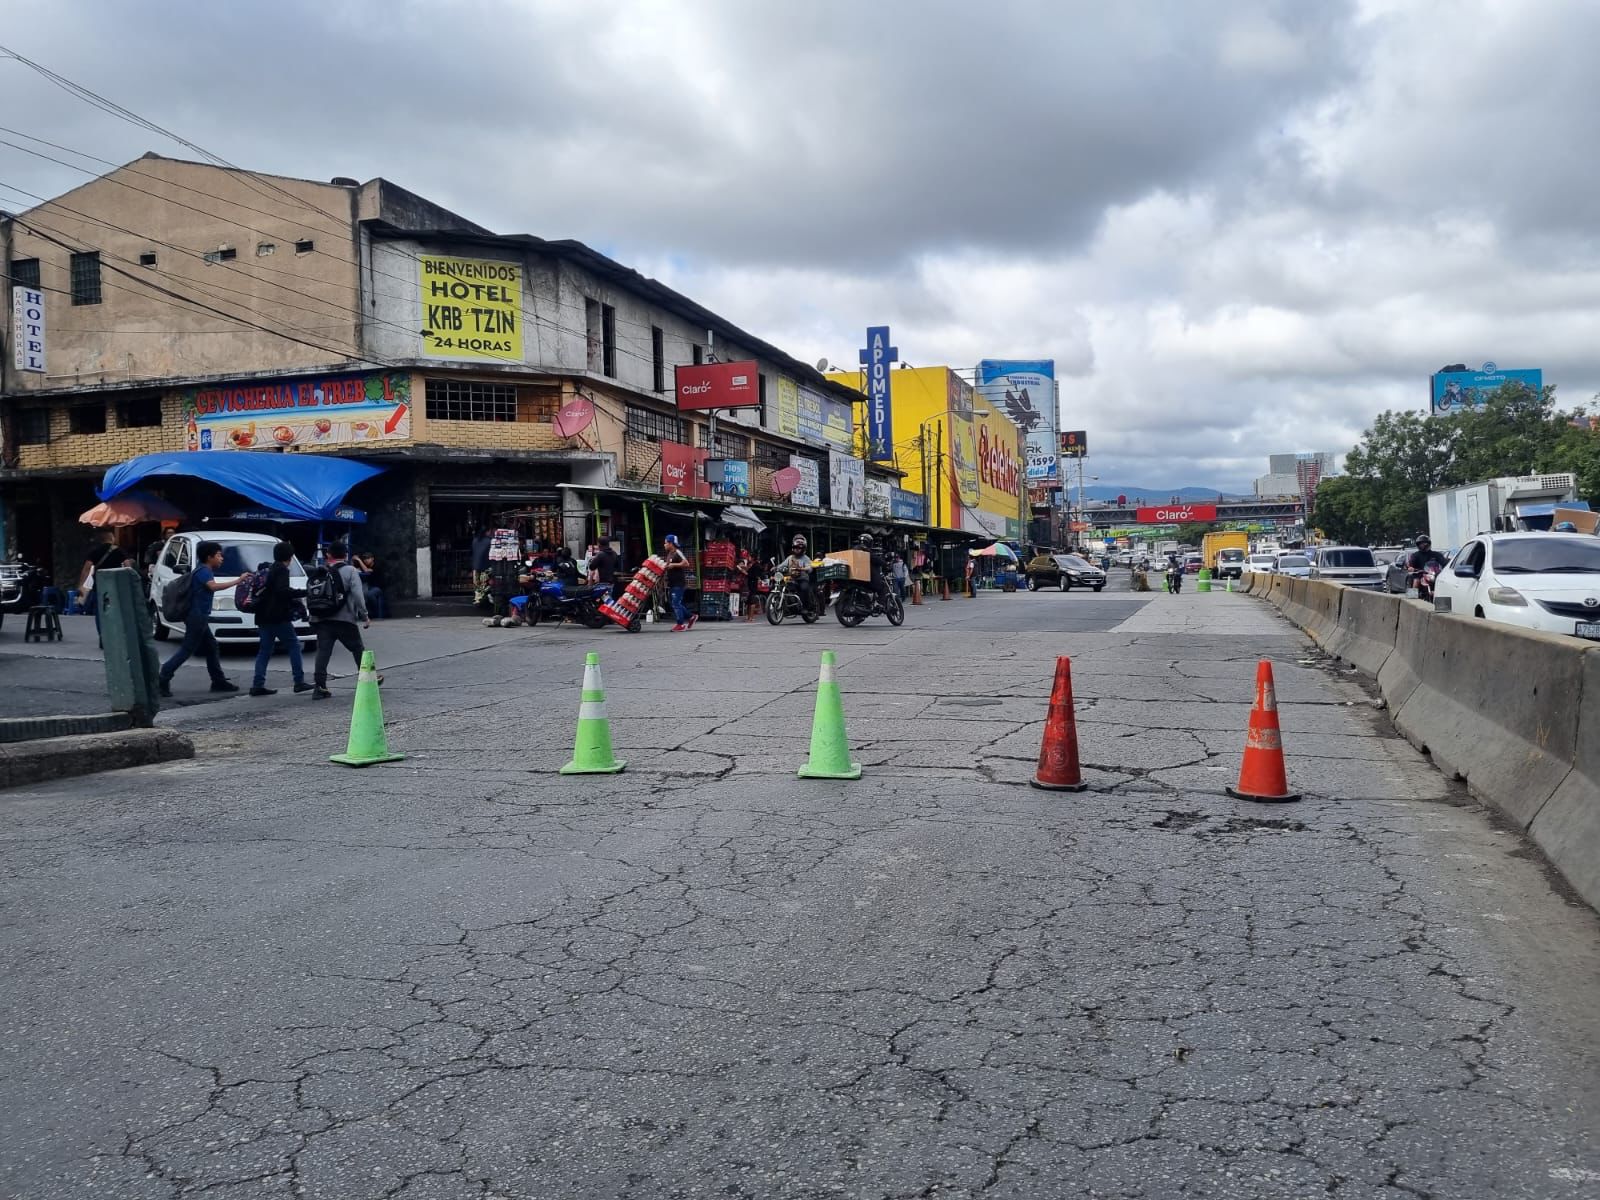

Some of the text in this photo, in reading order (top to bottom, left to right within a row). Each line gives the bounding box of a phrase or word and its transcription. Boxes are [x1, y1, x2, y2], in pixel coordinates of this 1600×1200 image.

[425, 260, 515, 281] BIENVENIDOS
[431, 281, 513, 303] HOTEL
[25, 291, 42, 369] HOTEL
[15, 325, 23, 365] HORAS
[434, 337, 512, 352] 24 HORAS
[196, 384, 295, 414] CEVICHERIA
[298, 383, 319, 406] EL
[682, 384, 708, 395] Claro
[872, 333, 886, 454] APOMEDIX
[666, 463, 684, 478] Claro
[1156, 509, 1188, 520] Claro
